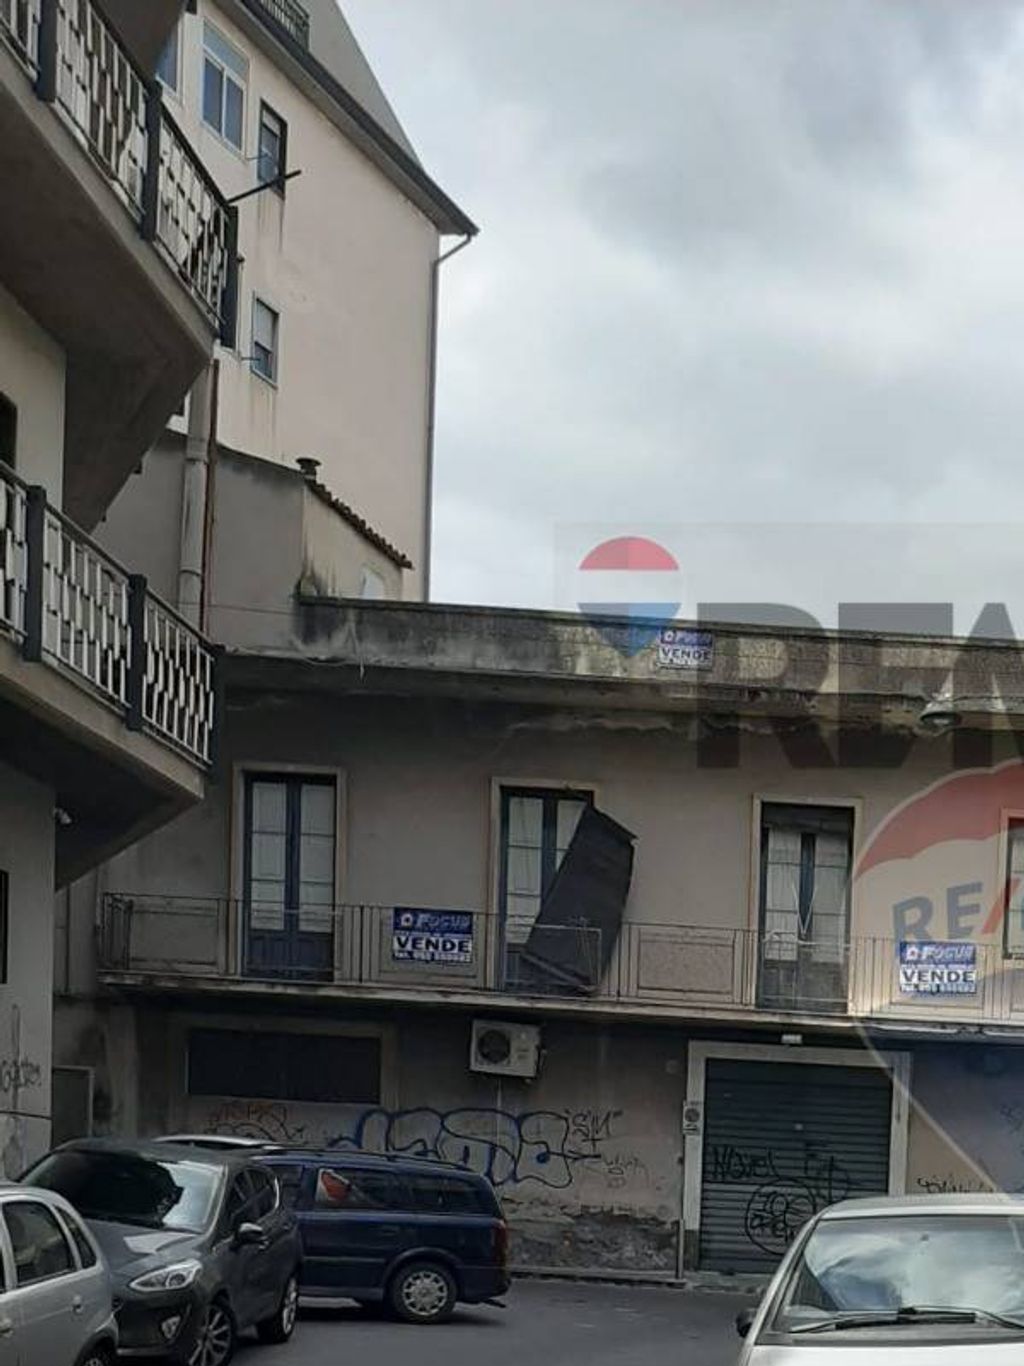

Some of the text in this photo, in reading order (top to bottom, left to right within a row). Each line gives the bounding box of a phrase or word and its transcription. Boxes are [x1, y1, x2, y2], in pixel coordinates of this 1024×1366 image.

[663, 648, 711, 661] VENDE
[397, 936, 472, 954] VENDE
[903, 970, 975, 983] VENDE
